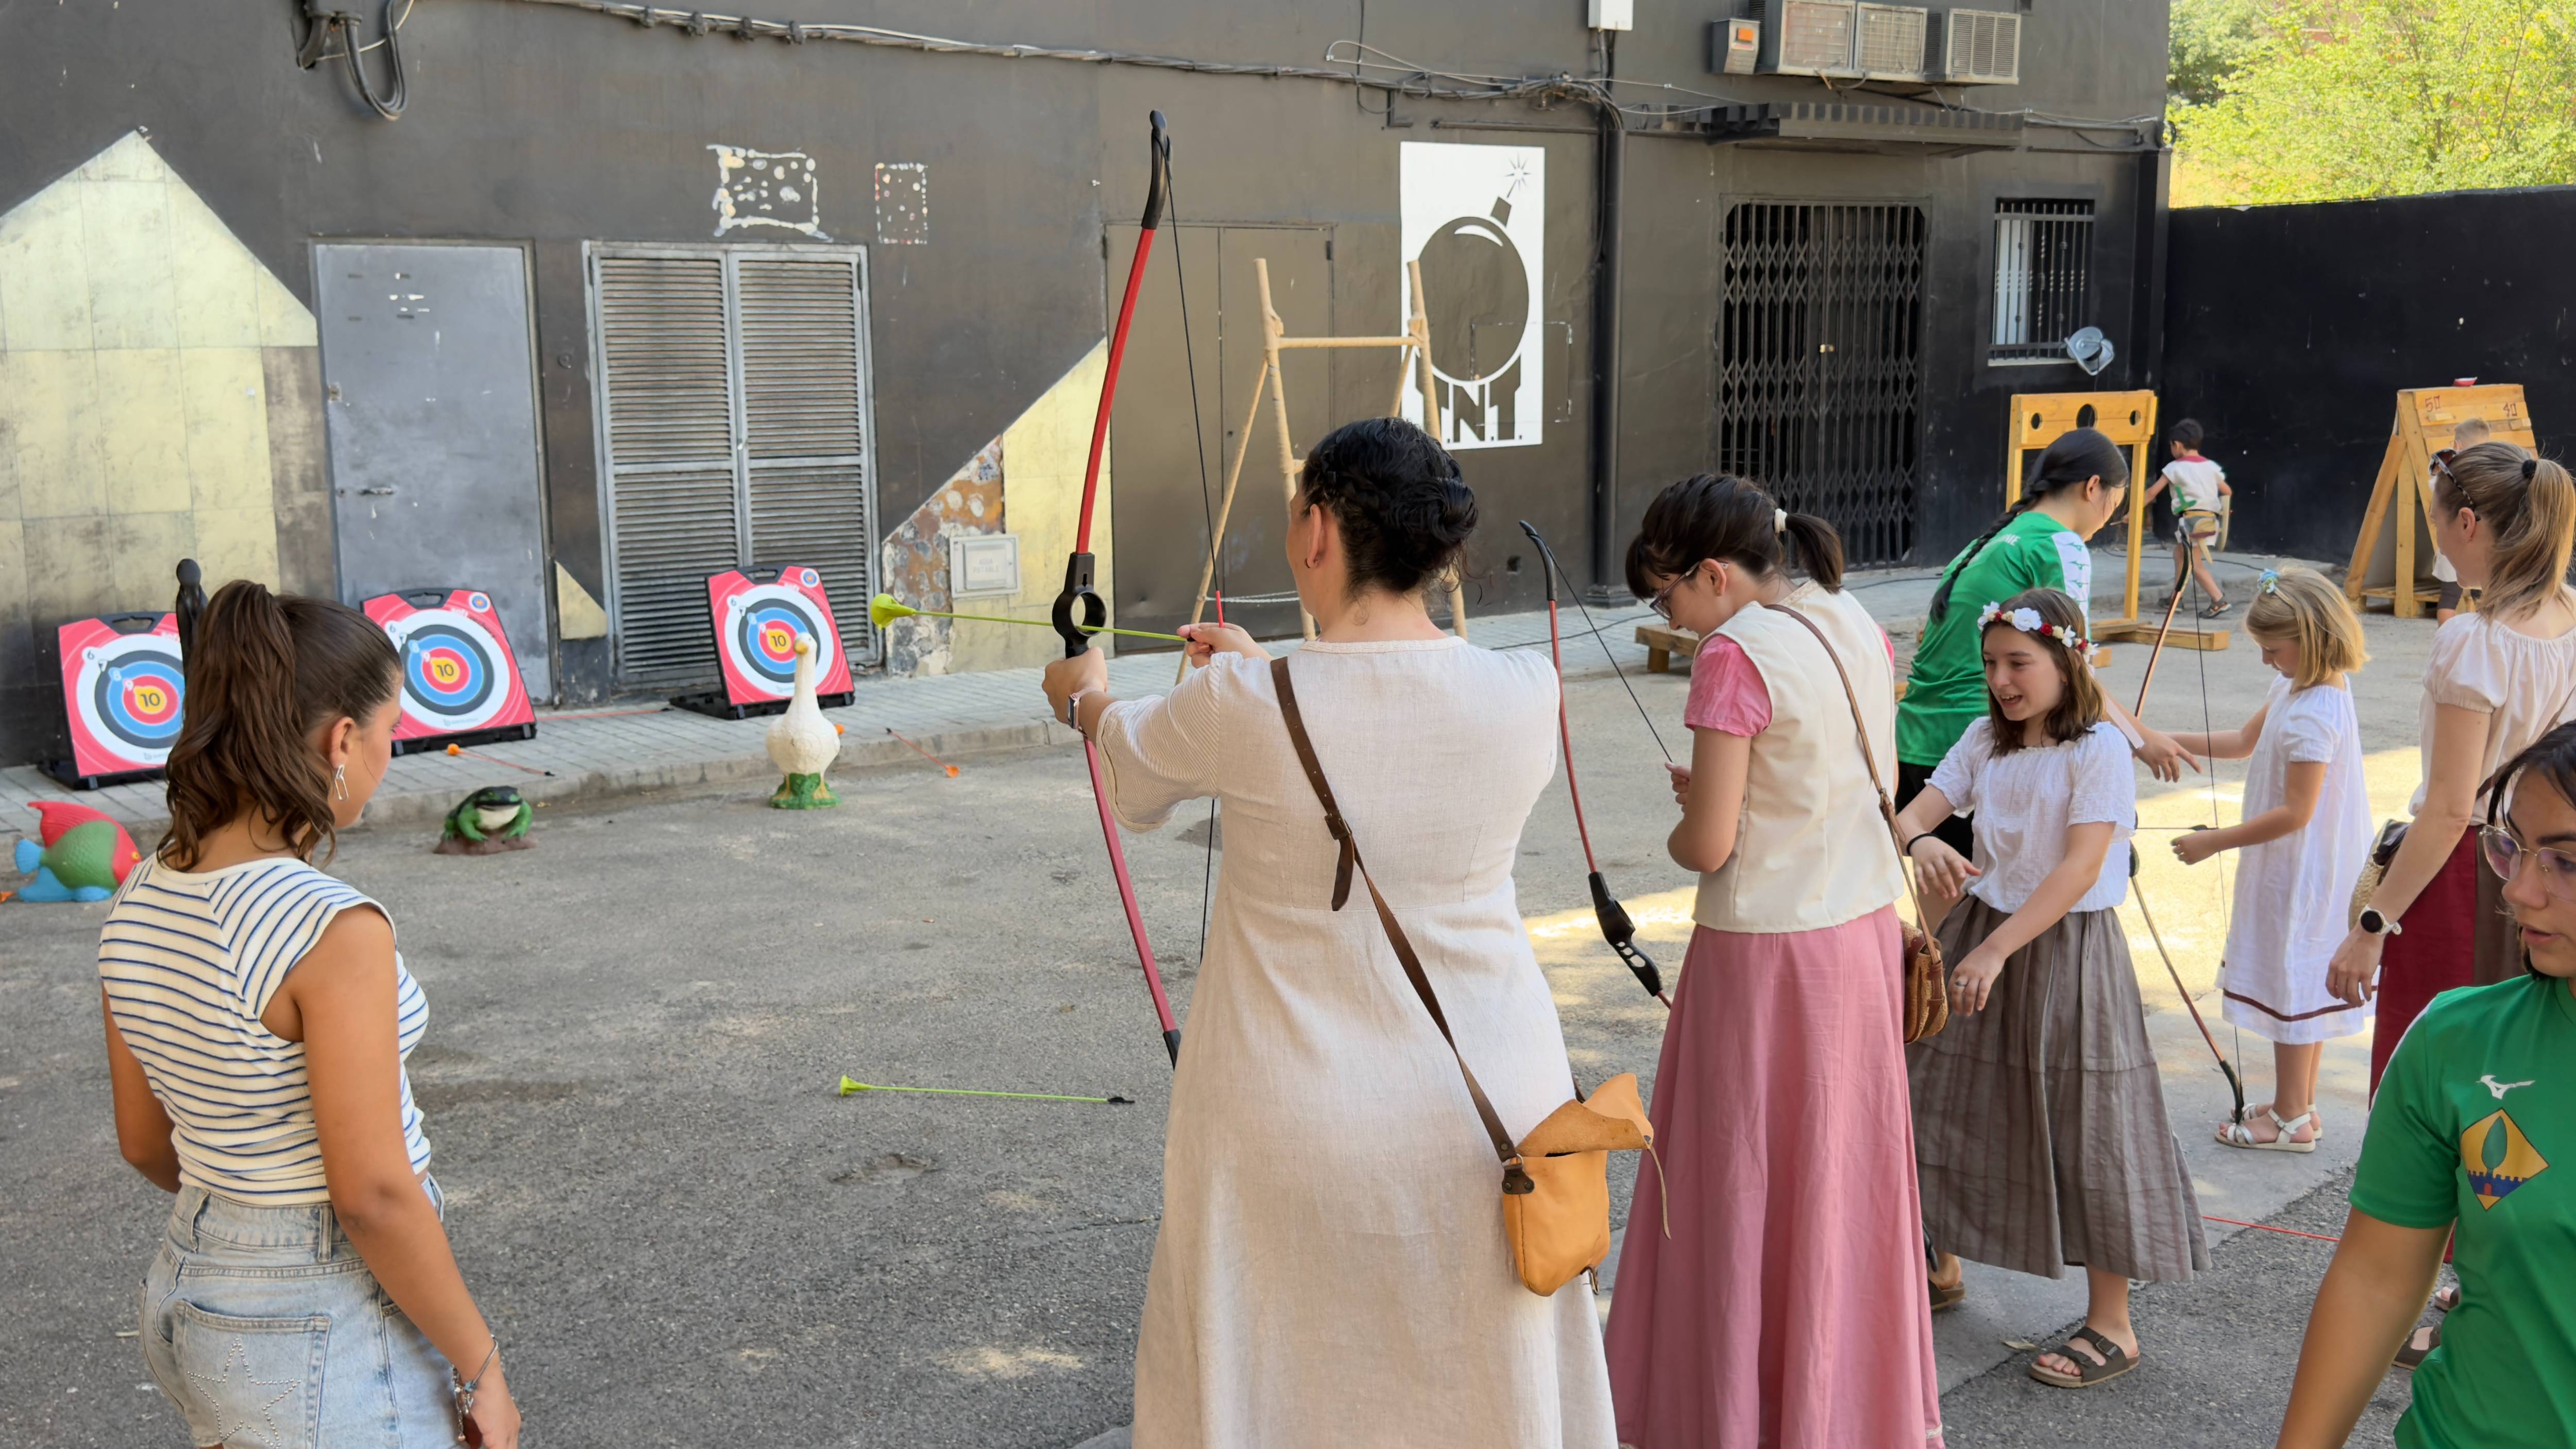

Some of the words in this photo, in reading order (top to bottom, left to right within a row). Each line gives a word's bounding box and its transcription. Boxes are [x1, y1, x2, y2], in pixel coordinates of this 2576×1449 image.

[2425, 395, 2441, 412] 50
[2503, 402, 2517, 417] 40
[731, 598, 737, 606] 6
[389, 623, 396, 633] 6
[772, 635, 786, 647] 10
[87, 650, 95, 660] 6
[437, 664, 454, 677] 10
[140, 693, 160, 707] 10
